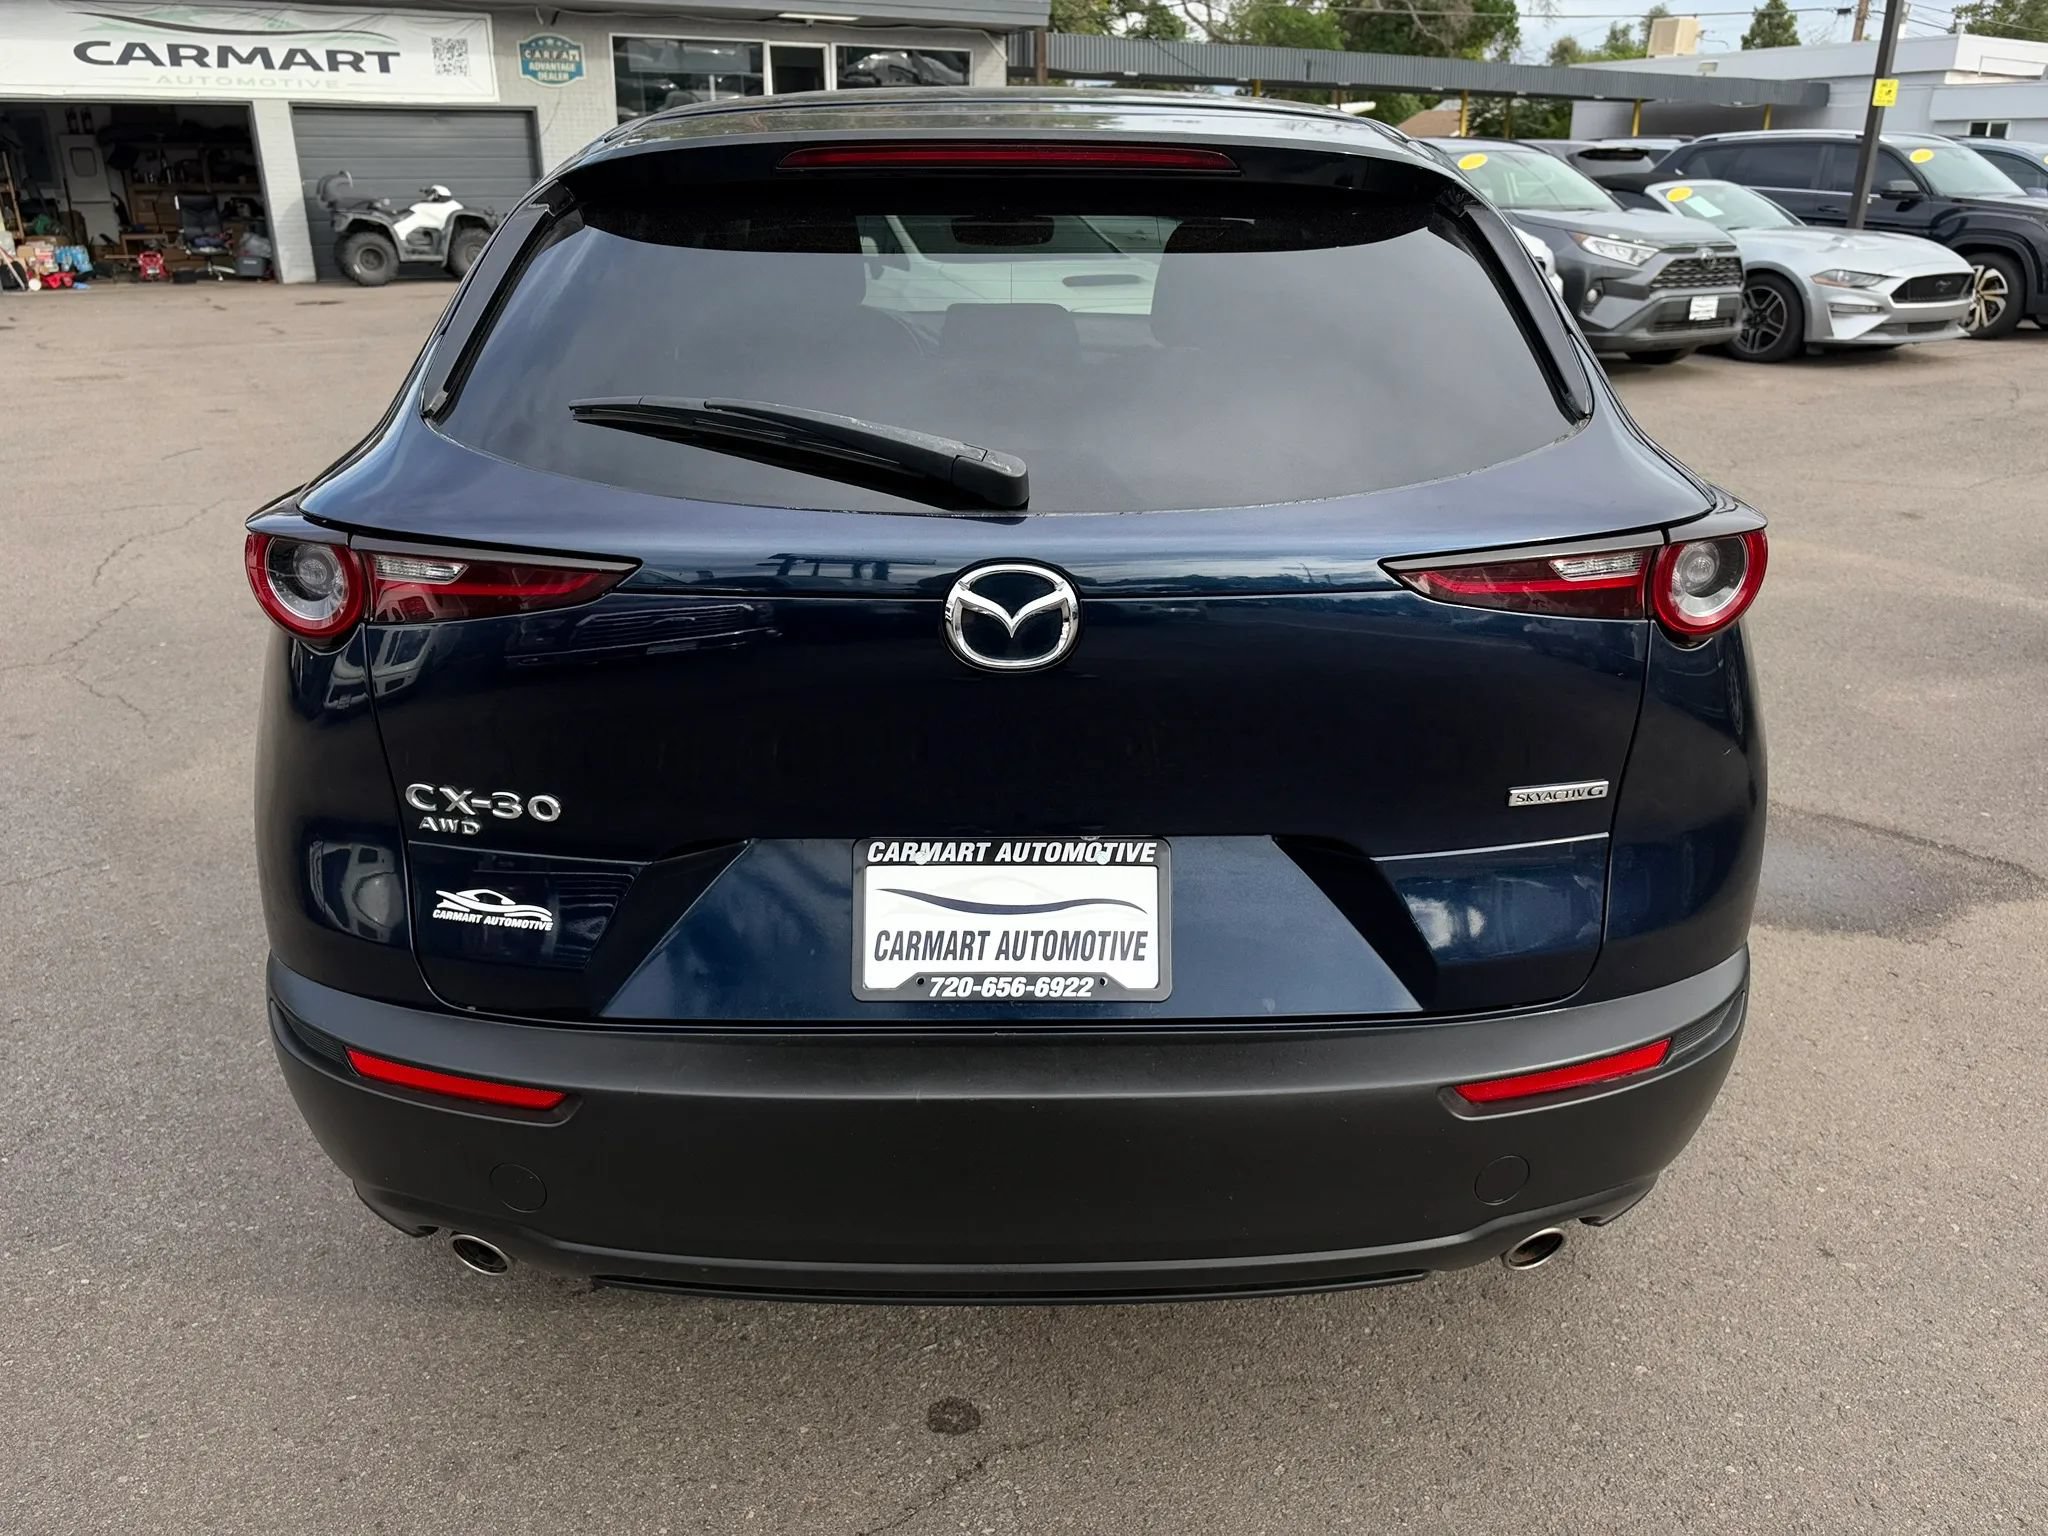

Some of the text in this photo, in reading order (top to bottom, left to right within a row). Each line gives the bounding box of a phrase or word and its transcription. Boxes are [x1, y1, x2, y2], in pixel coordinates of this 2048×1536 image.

[73, 41, 401, 73] CARMART
[528, 61, 577, 72] ADVANTAGE
[156, 74, 341, 89] AUTOMOTIVE
[537, 71, 570, 81] DEALER
[405, 783, 561, 822] CX-30
[1516, 789, 1585, 802] SKYACTIV
[418, 816, 481, 835] AWD
[867, 842, 1157, 863] CARMART AUTOMOTIVE
[432, 909, 553, 931] CARMART AUTOMOTIVE
[874, 930, 1148, 961] CARMART AUTOMOTIVE
[929, 976, 1094, 998] 720-656-6922
